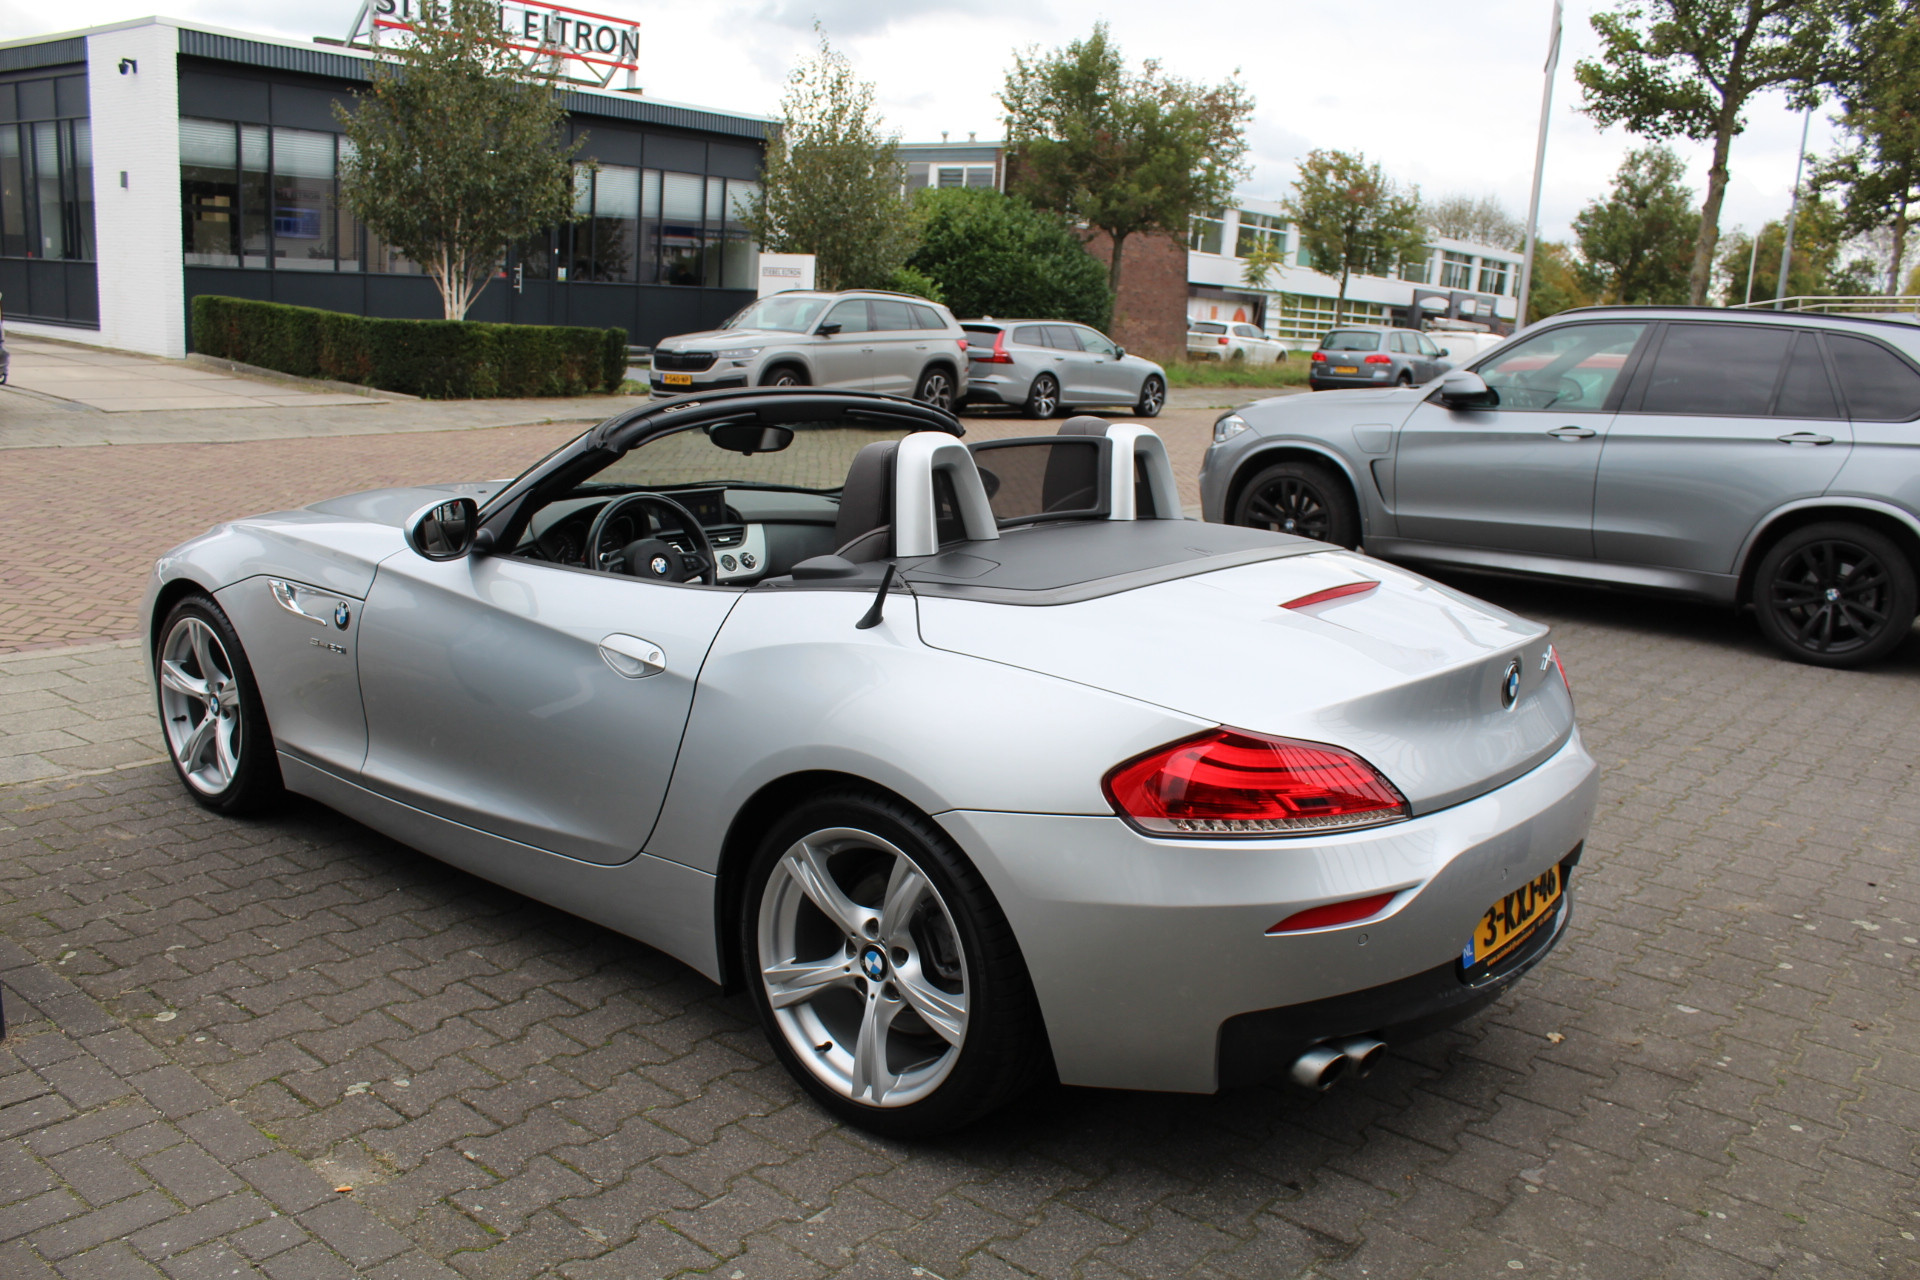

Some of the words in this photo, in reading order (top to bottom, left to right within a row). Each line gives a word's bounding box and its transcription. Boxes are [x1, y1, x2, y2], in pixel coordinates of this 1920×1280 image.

[524, 10, 640, 60] ELTRON
[1484, 867, 1556, 947] 3-KXJ-46
[1463, 944, 1473, 959] NL
